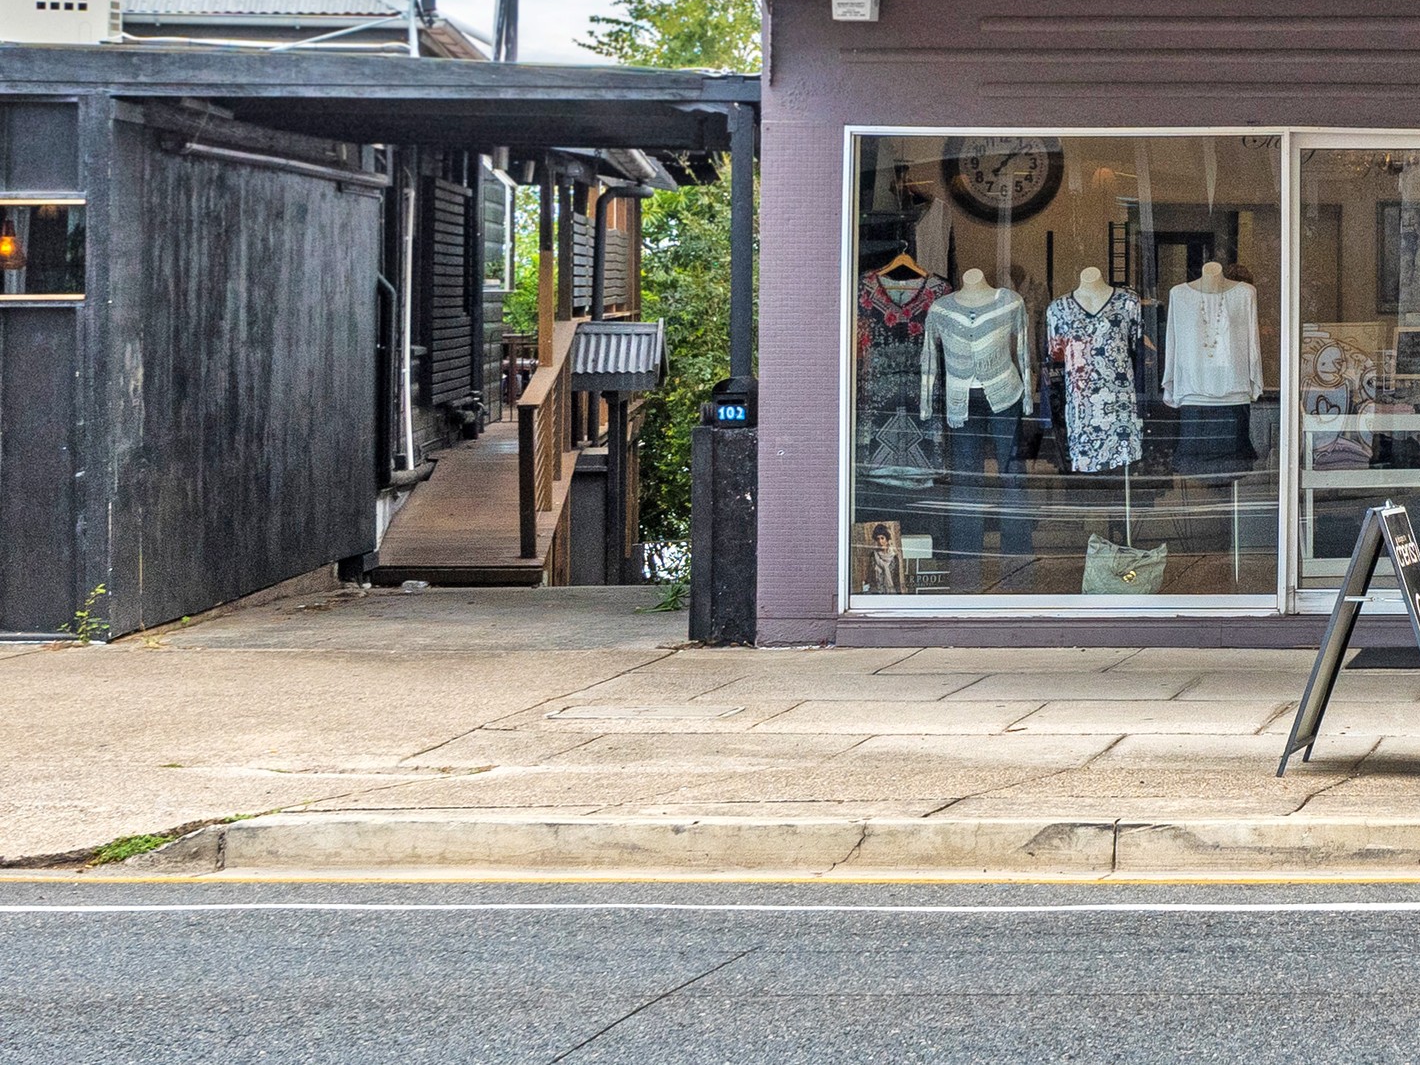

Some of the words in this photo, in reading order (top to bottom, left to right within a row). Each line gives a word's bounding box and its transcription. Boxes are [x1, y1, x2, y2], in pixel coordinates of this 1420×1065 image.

[1029, 157, 1038, 170] 3
[985, 181, 994, 193] 7
[1015, 181, 1023, 193] 5
[718, 406, 746, 421] 102
